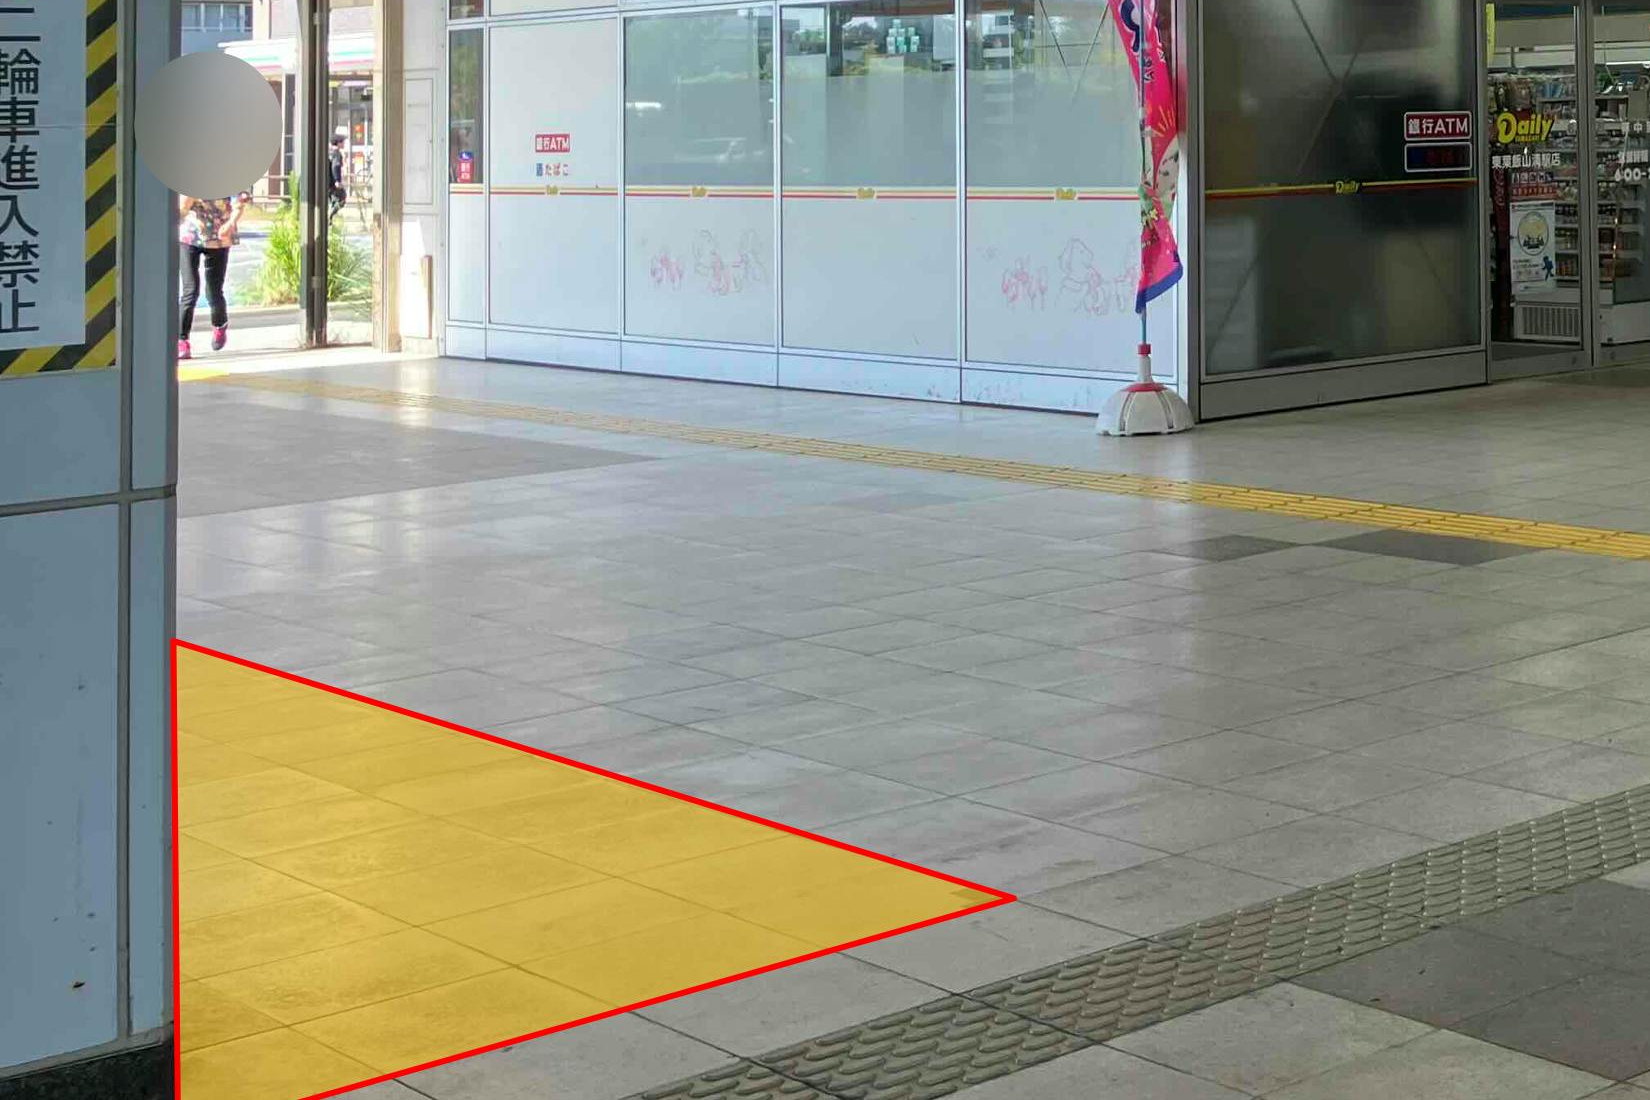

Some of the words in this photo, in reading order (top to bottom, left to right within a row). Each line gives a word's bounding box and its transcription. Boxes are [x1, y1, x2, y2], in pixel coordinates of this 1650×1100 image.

[1408, 118, 1468, 134] 銀行ATM
[1498, 112, 1555, 144] Daily
[0, 7, 41, 334] 二輪車進入禁止
